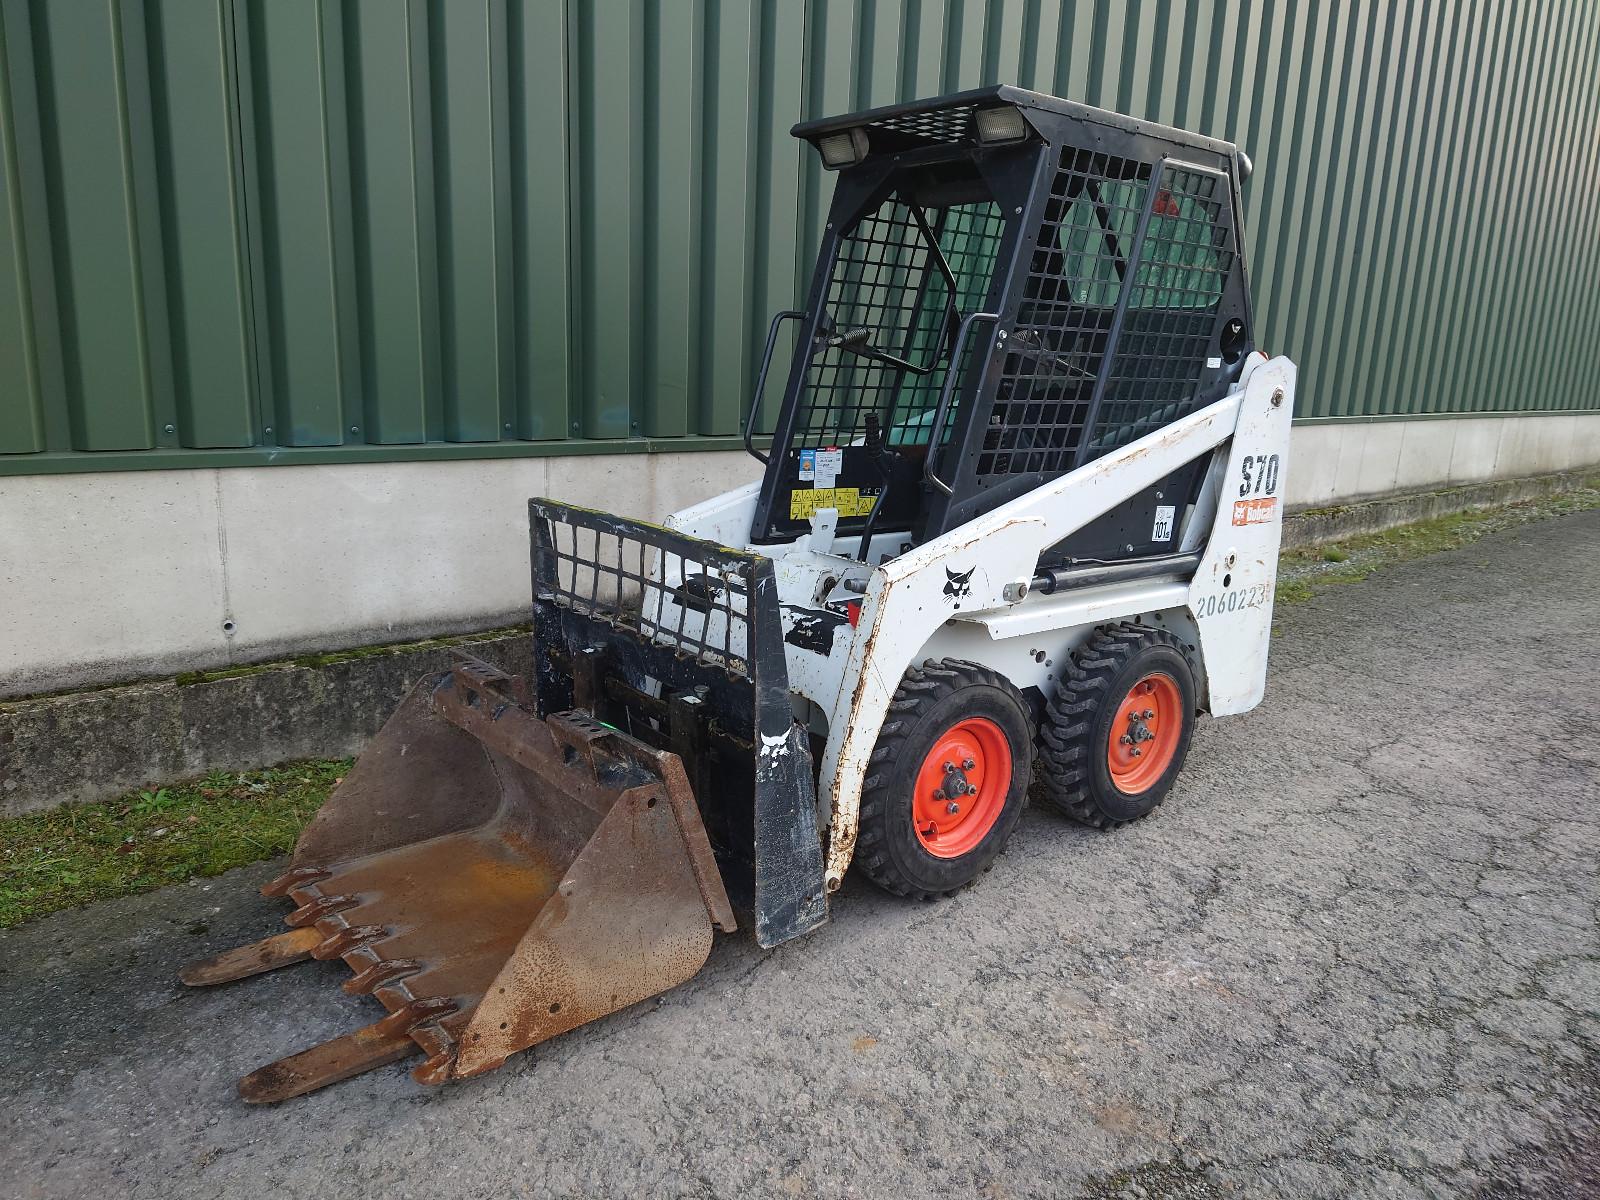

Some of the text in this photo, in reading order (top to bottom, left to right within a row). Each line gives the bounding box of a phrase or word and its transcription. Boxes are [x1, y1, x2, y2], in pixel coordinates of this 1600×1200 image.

[1240, 454, 1280, 497] S70
[1247, 505, 1274, 521] Bobcat
[1155, 522, 1168, 538] 101
